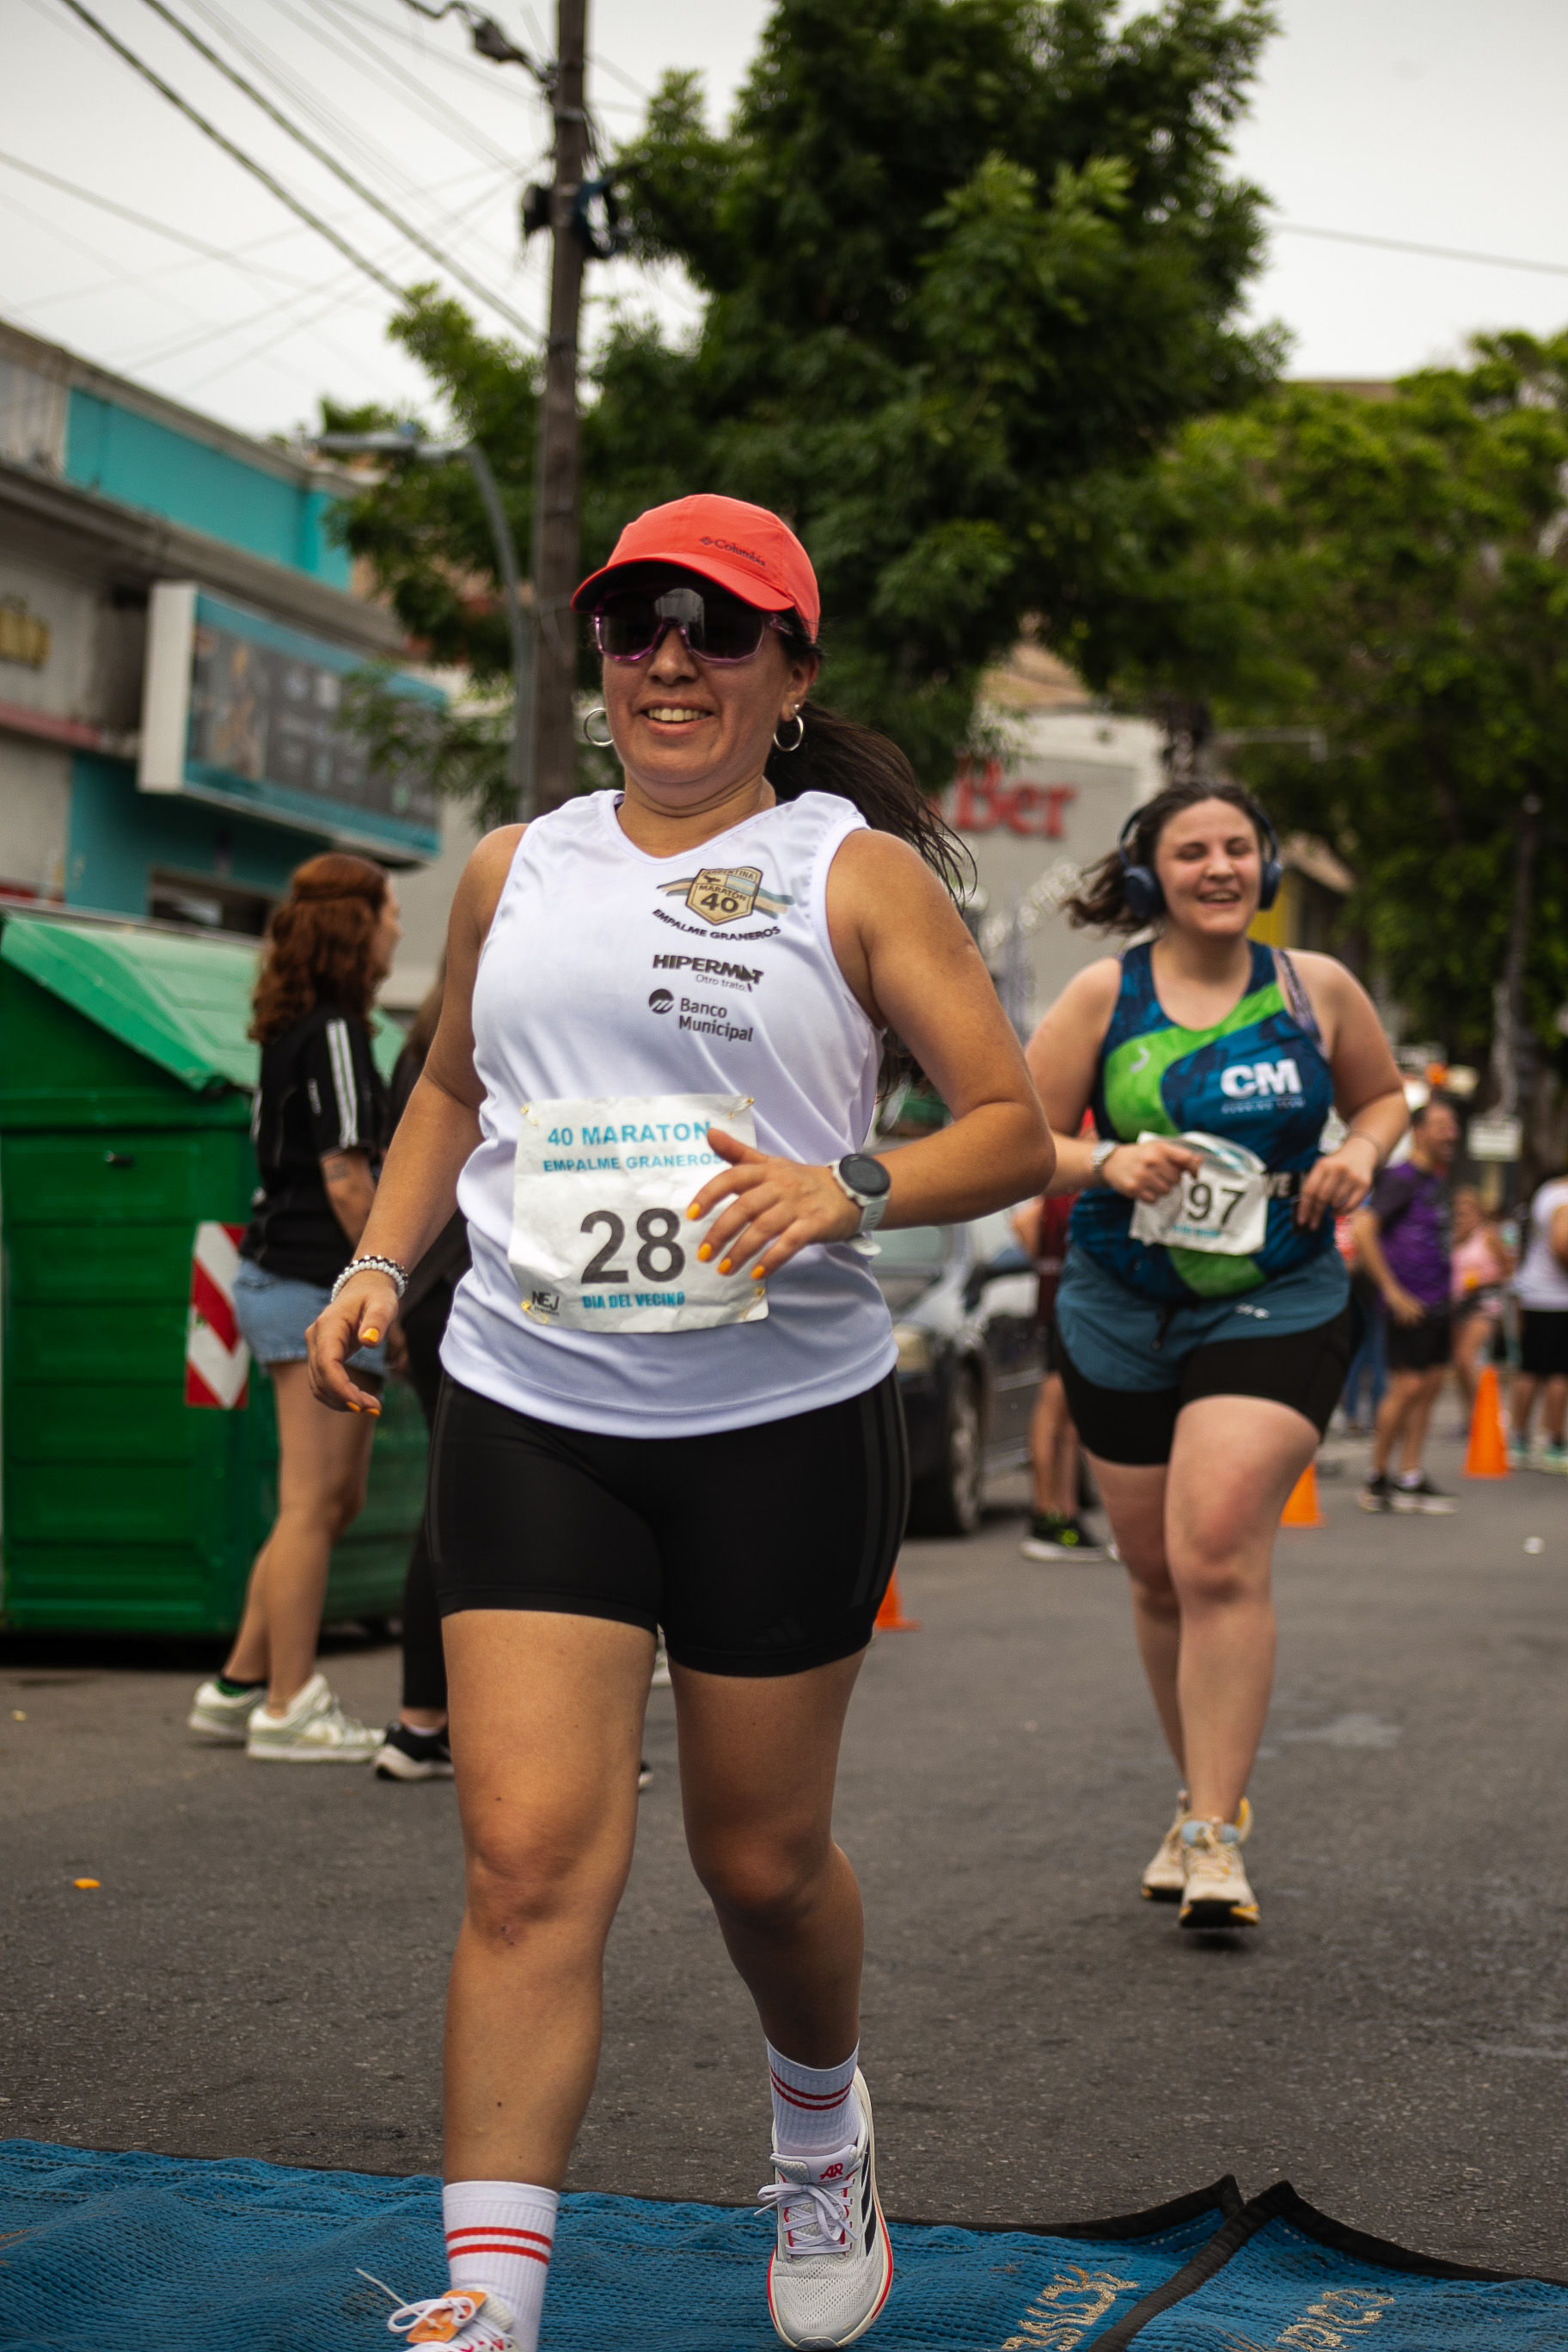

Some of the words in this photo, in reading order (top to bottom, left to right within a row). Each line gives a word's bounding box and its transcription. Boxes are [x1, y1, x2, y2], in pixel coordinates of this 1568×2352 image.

[714, 539, 765, 567] Columbia
[701, 893, 738, 913] 40
[652, 909, 707, 937] EMPALME
[710, 926, 781, 941] GRANEROS
[695, 974, 719, 985] Otro
[680, 997, 727, 1019] Banco
[678, 1015, 754, 1042] Municipal
[1221, 1058, 1302, 1099] CM
[548, 1127, 573, 1146] 40
[582, 1121, 711, 1145] MARATON
[543, 1158, 621, 1172] EMPALME
[1187, 1184, 1246, 1227] 97
[580, 1208, 686, 1284] 28
[609, 1294, 632, 1308] DEL
[634, 1291, 686, 1308] VECINO
